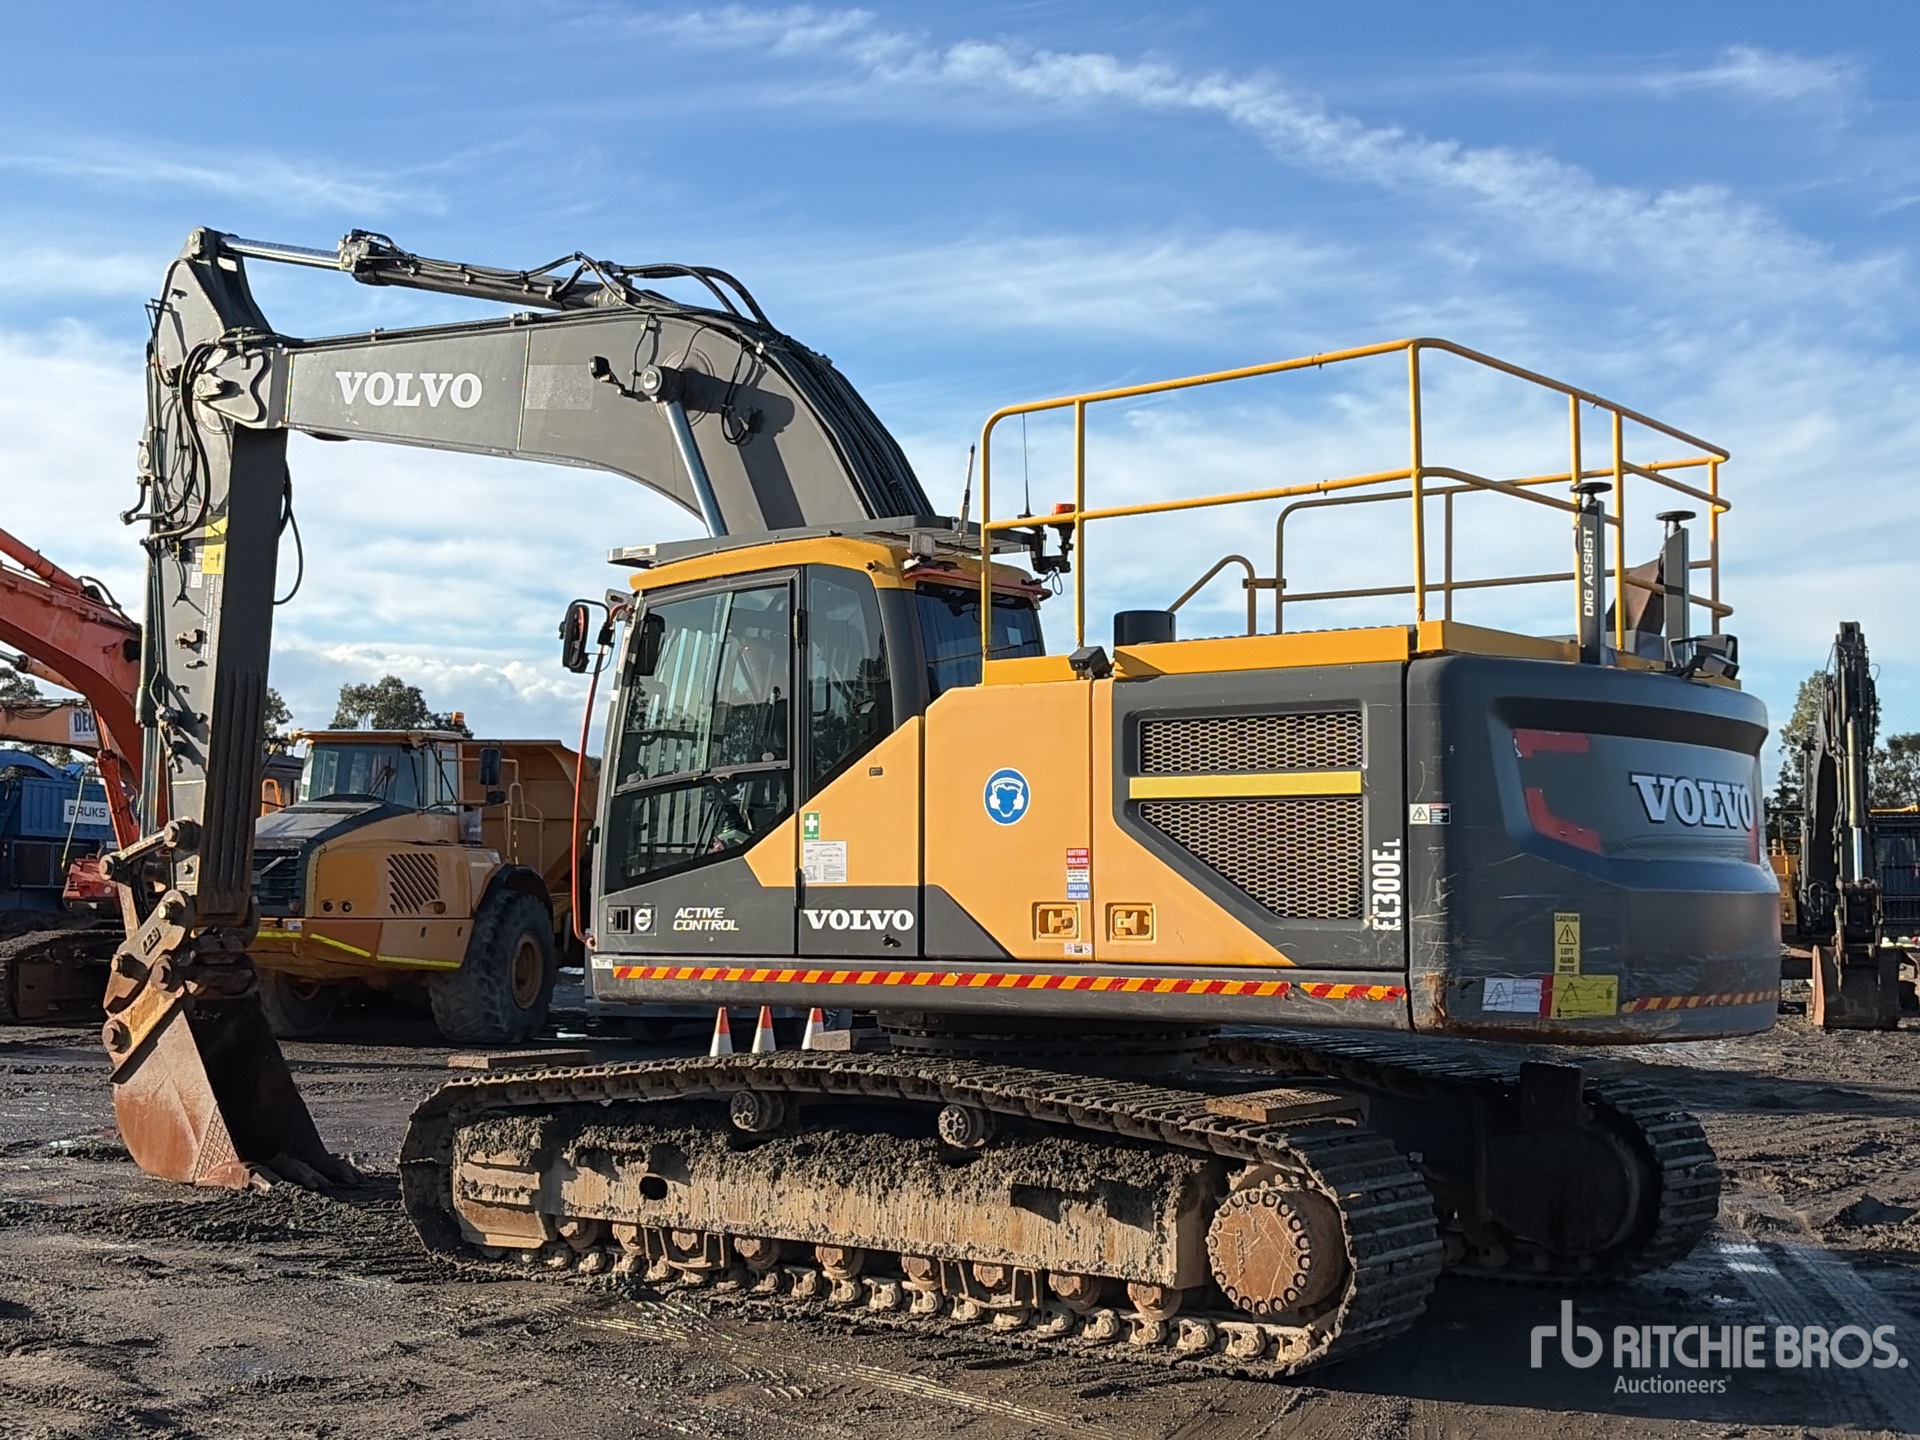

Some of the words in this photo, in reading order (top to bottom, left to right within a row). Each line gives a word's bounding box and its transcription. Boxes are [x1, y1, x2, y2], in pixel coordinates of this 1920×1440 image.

[335, 371, 483, 409] VOLVO
[1583, 527, 1594, 586] ASSIST
[1583, 589, 1594, 617] DIG
[1629, 772, 1754, 831] VOLVO
[68, 805, 106, 818] BRUKS
[1371, 838, 1401, 931] EC300EL
[674, 907, 726, 919] ACTIVE
[803, 908, 915, 931] VOLVO
[1556, 915, 1579, 923] CAUTION
[672, 919, 740, 931] CONTROL
[1560, 948, 1574, 956] LEFT
[1559, 965, 1575, 973] DRIVE
